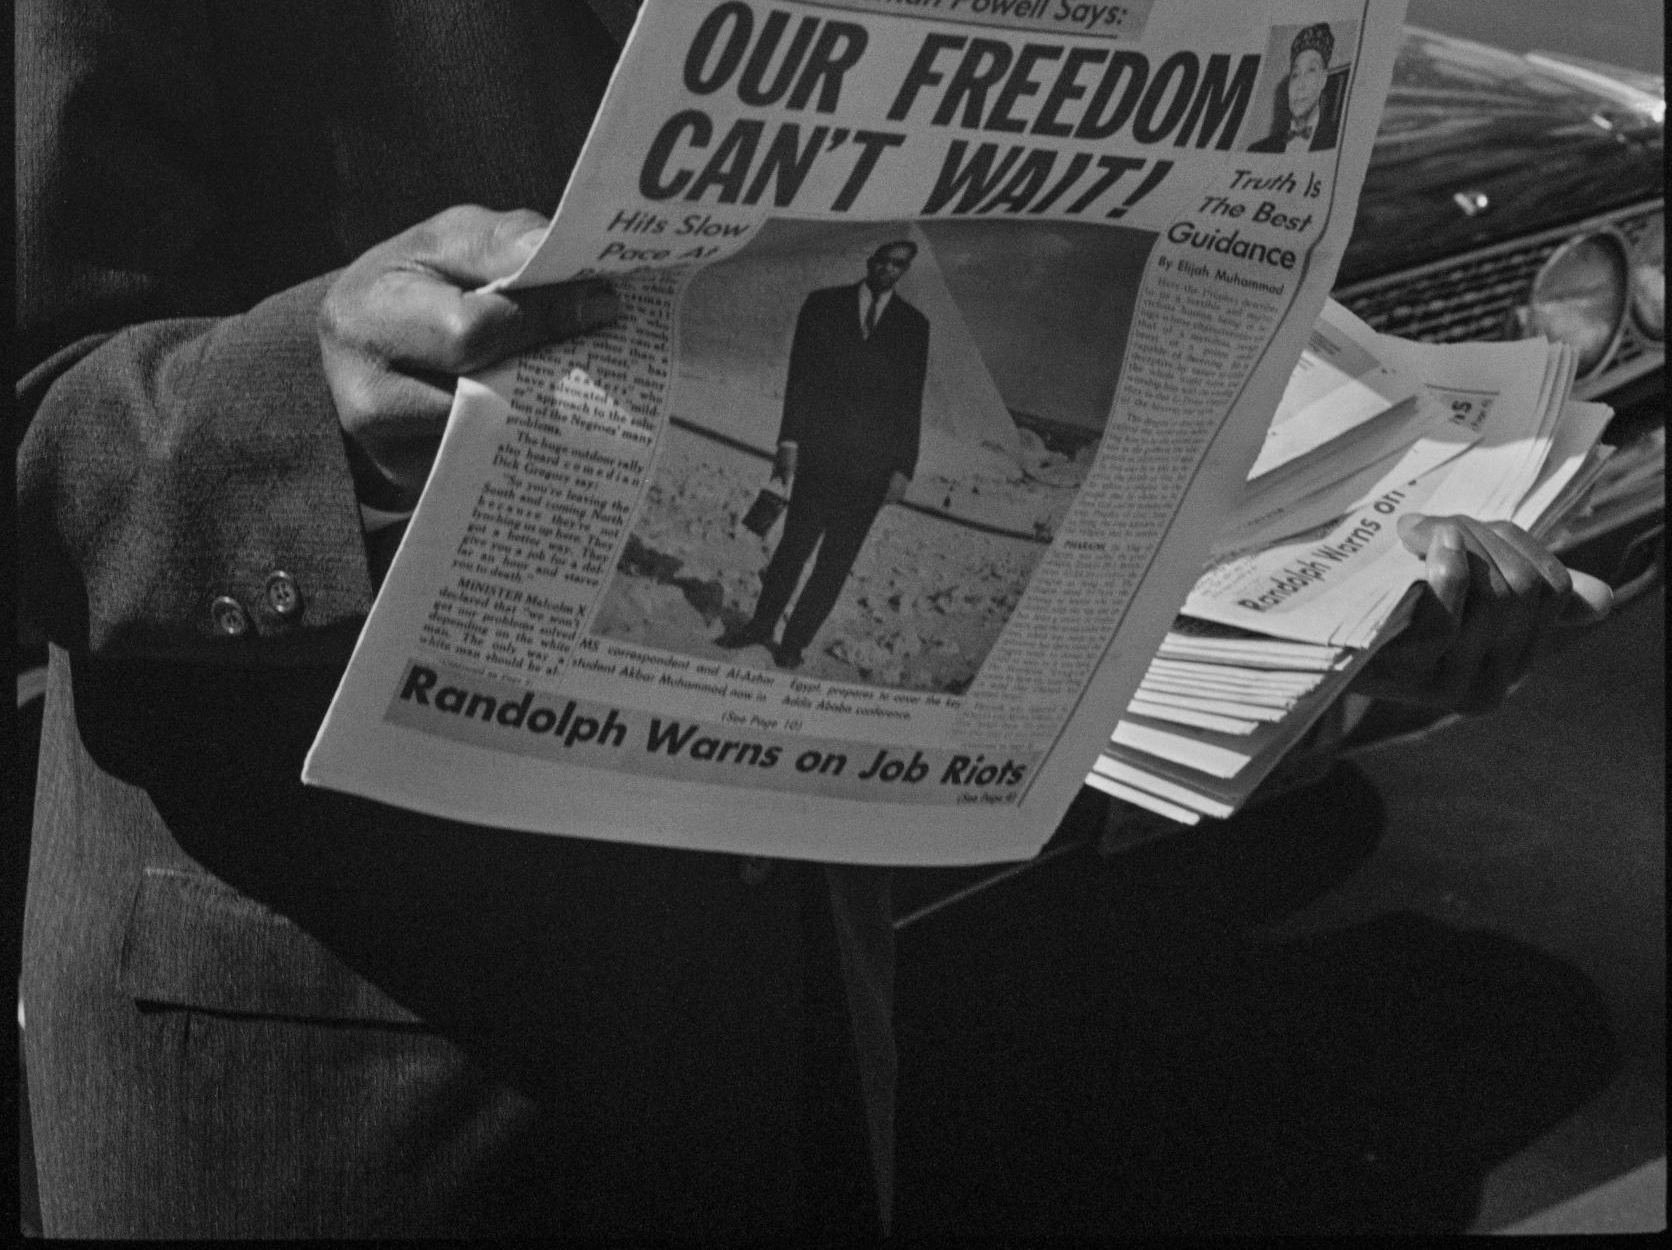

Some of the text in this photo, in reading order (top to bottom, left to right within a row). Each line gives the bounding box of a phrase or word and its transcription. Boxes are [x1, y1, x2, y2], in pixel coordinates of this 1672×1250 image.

[682, 0, 1261, 152] OUR FREEDOM
[638, 109, 1175, 218] CAN'T WAIT!
[1230, 169, 1322, 198] Truth Is
[607, 209, 750, 238] Hits Slow
[1199, 196, 1313, 232] The Best
[597, 241, 671, 261] Pace
[1167, 221, 1296, 270] Guidance
[1158, 256, 1285, 296] By Elijah Muhammad
[510, 398, 533, 414] tion
[535, 406, 548, 417] of
[550, 408, 568, 422] the
[622, 429, 652, 446] many
[536, 393, 590, 414] approach
[594, 406, 605, 418] to
[609, 409, 627, 424] the
[492, 453, 519, 470] Dick
[525, 462, 571, 482] Gregory
[498, 443, 521, 457] also
[526, 447, 560, 466] heard
[517, 429, 645, 474] The huge outdoor rally
[482, 481, 623, 525] South and coming North
[567, 488, 608, 511] leaving
[611, 500, 630, 514] the
[588, 534, 614, 550] They
[601, 527, 619, 539] not
[480, 552, 495, 563] an
[535, 566, 559, 578] and
[564, 573, 600, 586] starve
[583, 547, 610, 563] They
[1238, 559, 1332, 614] Randolph
[1311, 517, 1381, 563] Warns
[439, 585, 490, 608] declared
[494, 600, 518, 614] that
[458, 577, 587, 618] MINISTER Malcolm X
[428, 610, 571, 653] depending on the white
[482, 611, 536, 631] problems
[419, 635, 452, 651] white
[455, 645, 482, 660] man
[485, 651, 525, 669] should
[527, 659, 541, 672] be
[463, 630, 485, 647] The
[527, 649, 550, 663] way
[607, 645, 690, 671] correspondent
[696, 663, 722, 677] and
[572, 656, 617, 675] student
[619, 664, 656, 682] Akbar
[729, 687, 754, 701] now
[400, 664, 1028, 787] Randolph Warns on Job Riots
